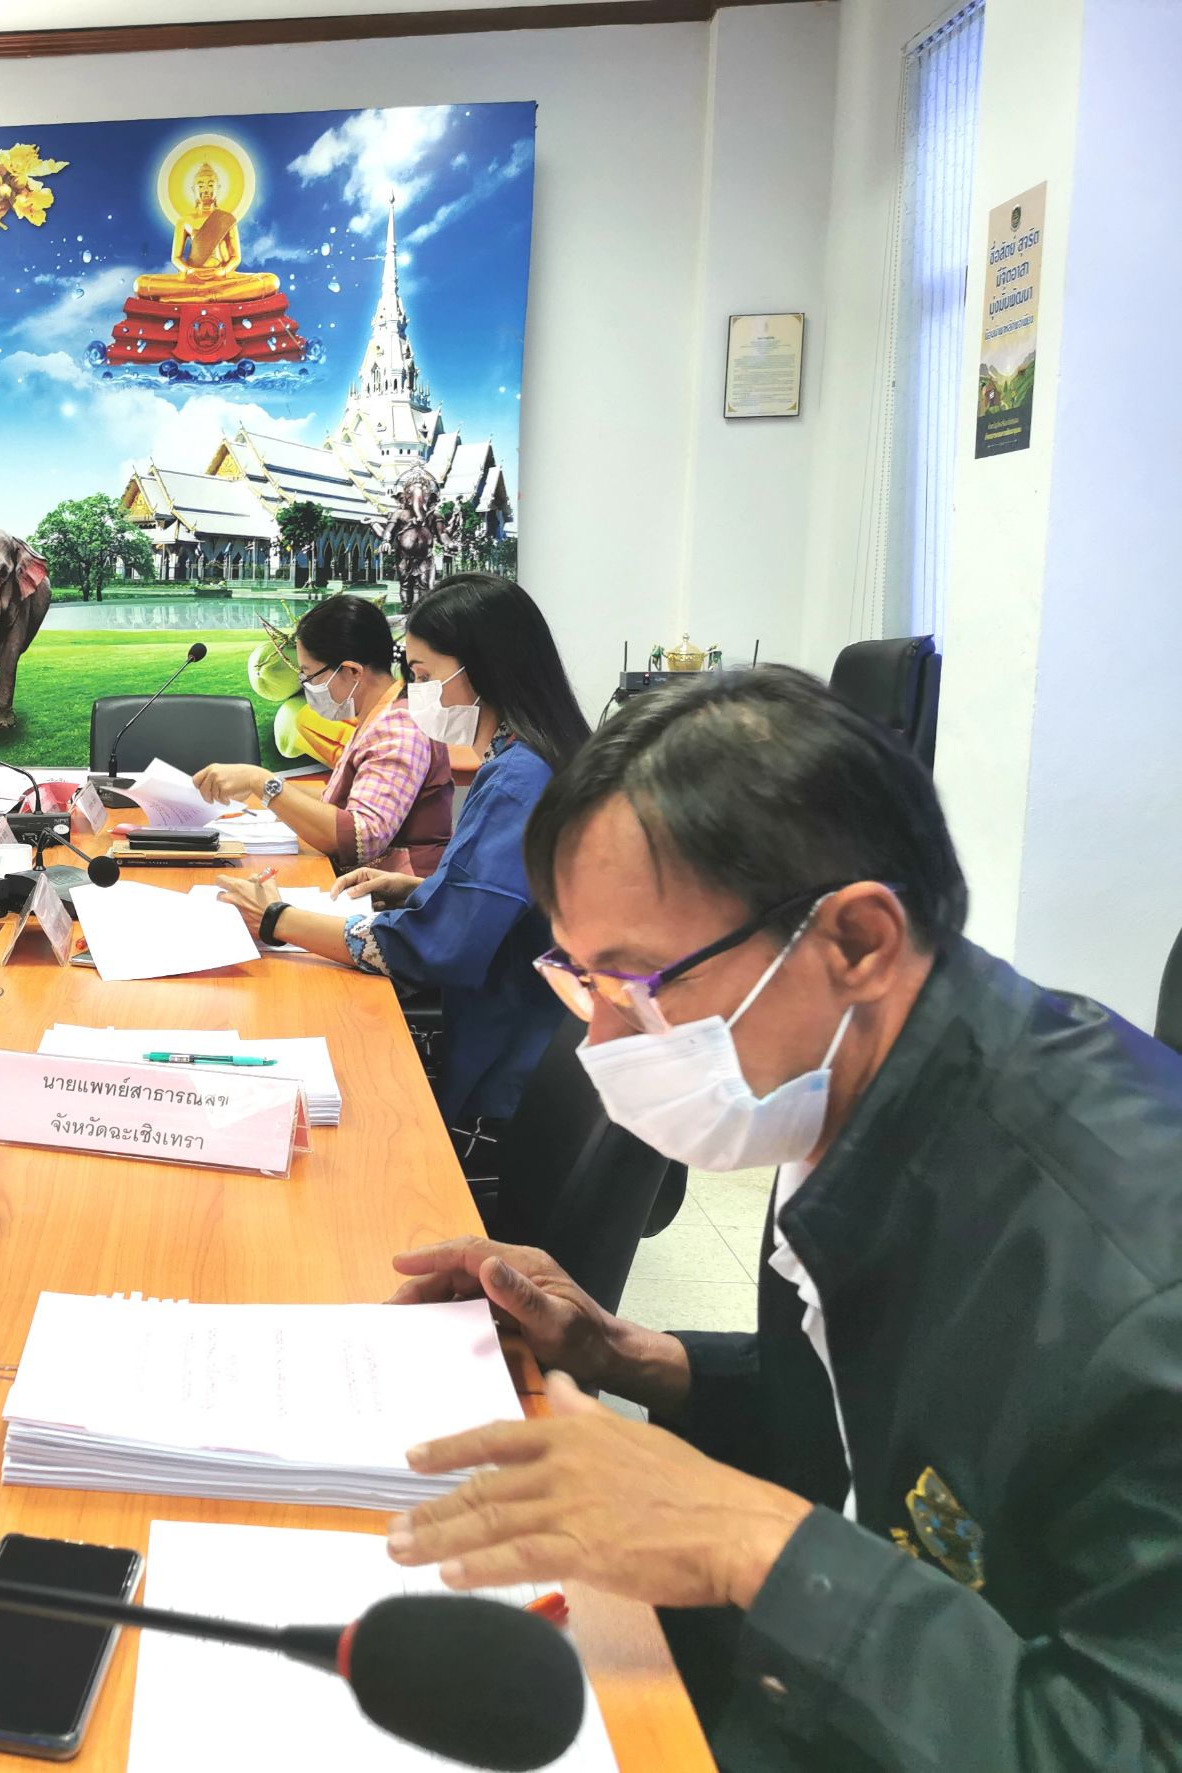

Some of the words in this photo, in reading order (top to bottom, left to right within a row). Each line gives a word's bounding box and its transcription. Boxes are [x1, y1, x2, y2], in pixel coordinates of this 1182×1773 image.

[1017, 227, 1040, 257] สุจริต
[42, 1075, 231, 1115] นายแพทย์สาธารณสุข
[50, 1111, 205, 1151] จังหวัดฉะเชิงเทรา
